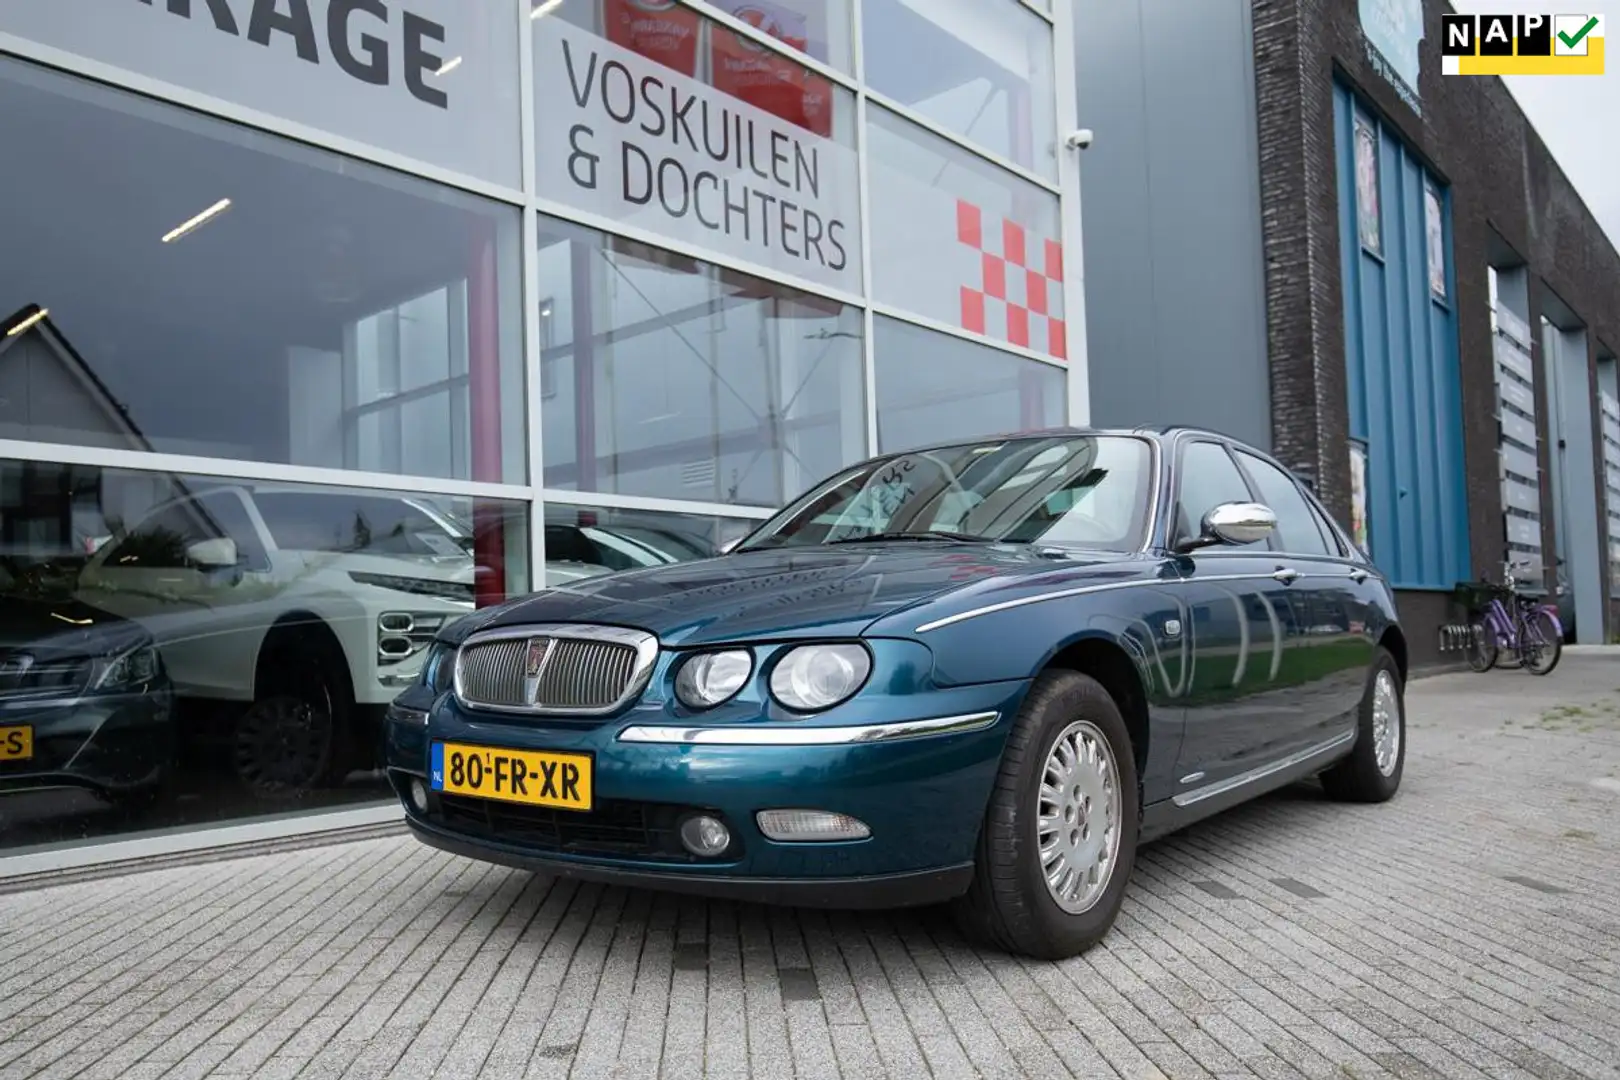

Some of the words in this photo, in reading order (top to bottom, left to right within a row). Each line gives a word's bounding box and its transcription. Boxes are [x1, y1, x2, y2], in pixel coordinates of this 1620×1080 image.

[562, 38, 819, 199] VOSKUILEN
[568, 123, 600, 190] &
[622, 140, 847, 272] DOCHTERS
[433, 770, 443, 783] NL
[450, 751, 581, 802] 80-FR-XR
